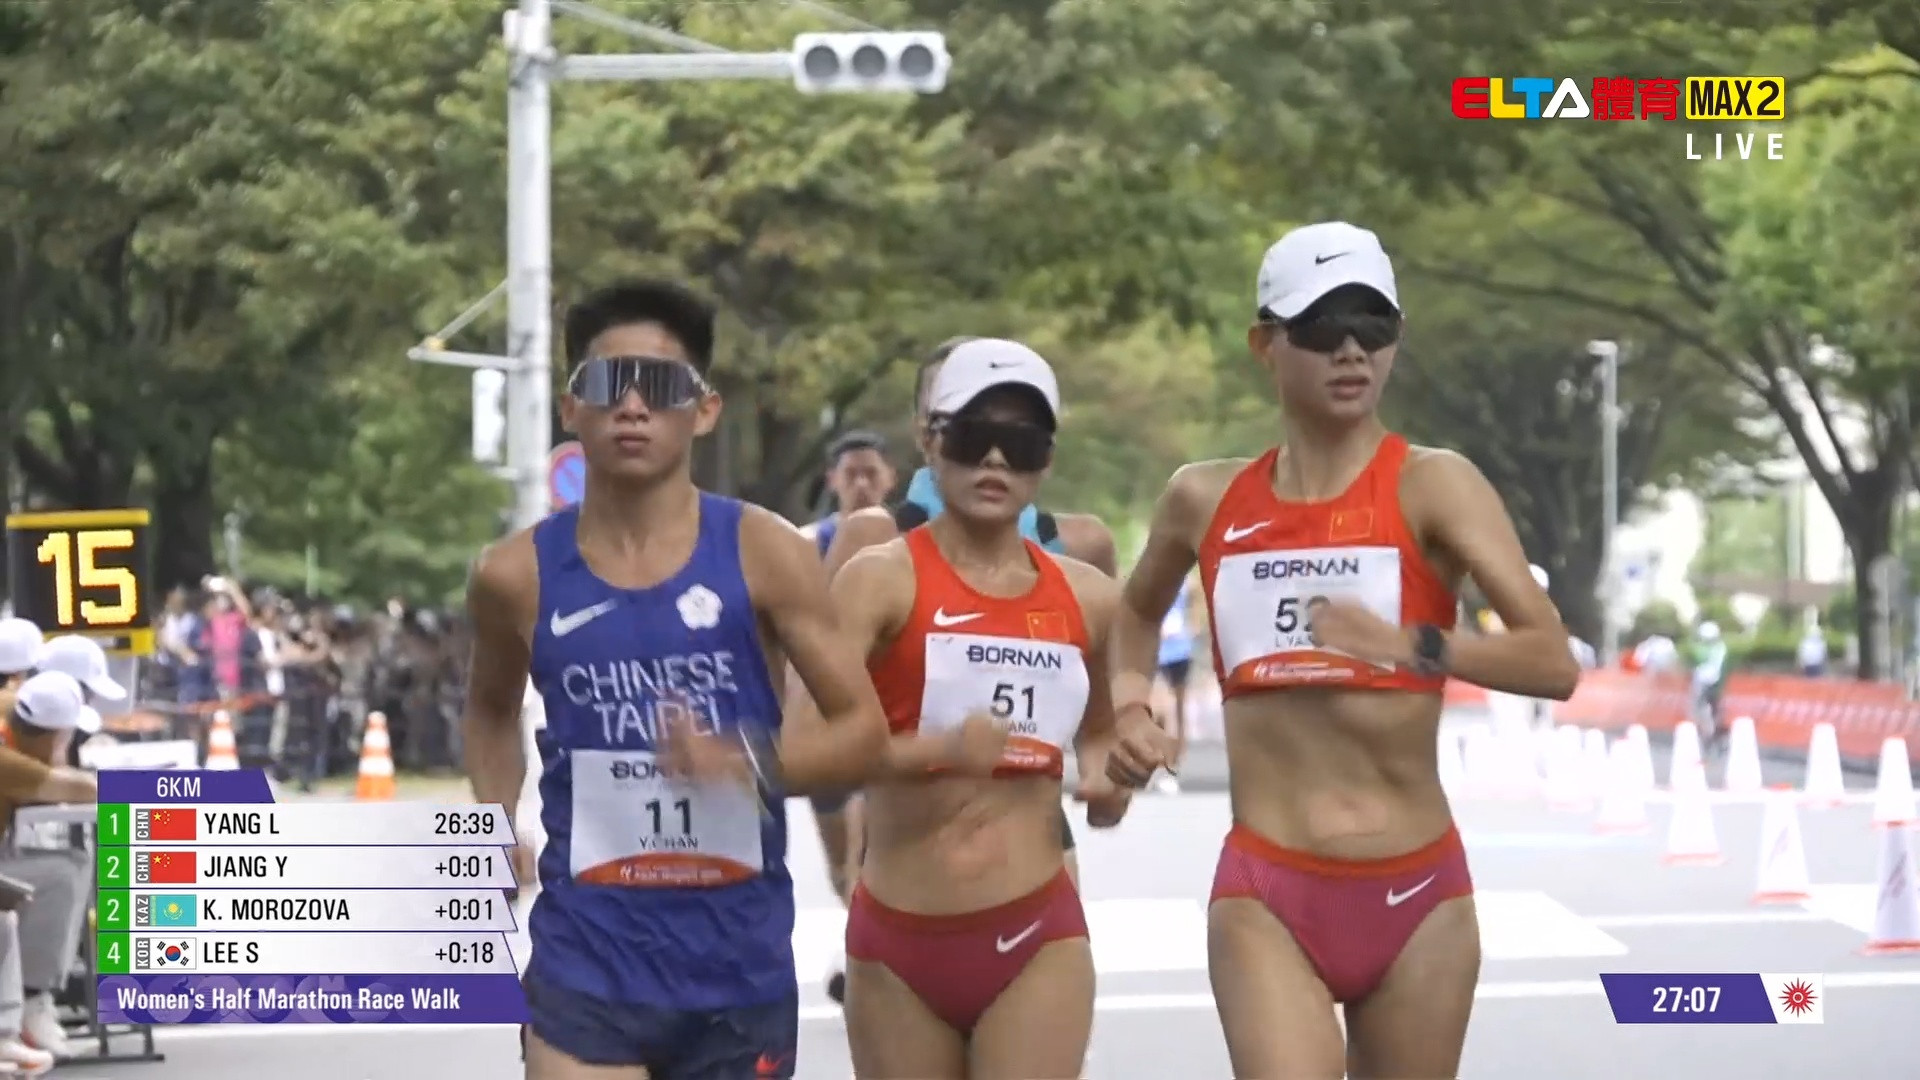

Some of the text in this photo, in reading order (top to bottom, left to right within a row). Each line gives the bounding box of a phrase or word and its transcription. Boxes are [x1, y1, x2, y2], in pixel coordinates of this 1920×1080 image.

[37, 529, 138, 626] 15
[1252, 557, 1359, 580] BORNAN
[966, 645, 1062, 669] BORNAN
[562, 651, 738, 706] CHINESE
[593, 693, 721, 745] TAIPEI
[990, 682, 1035, 719] 51
[645, 799, 692, 834] 11
